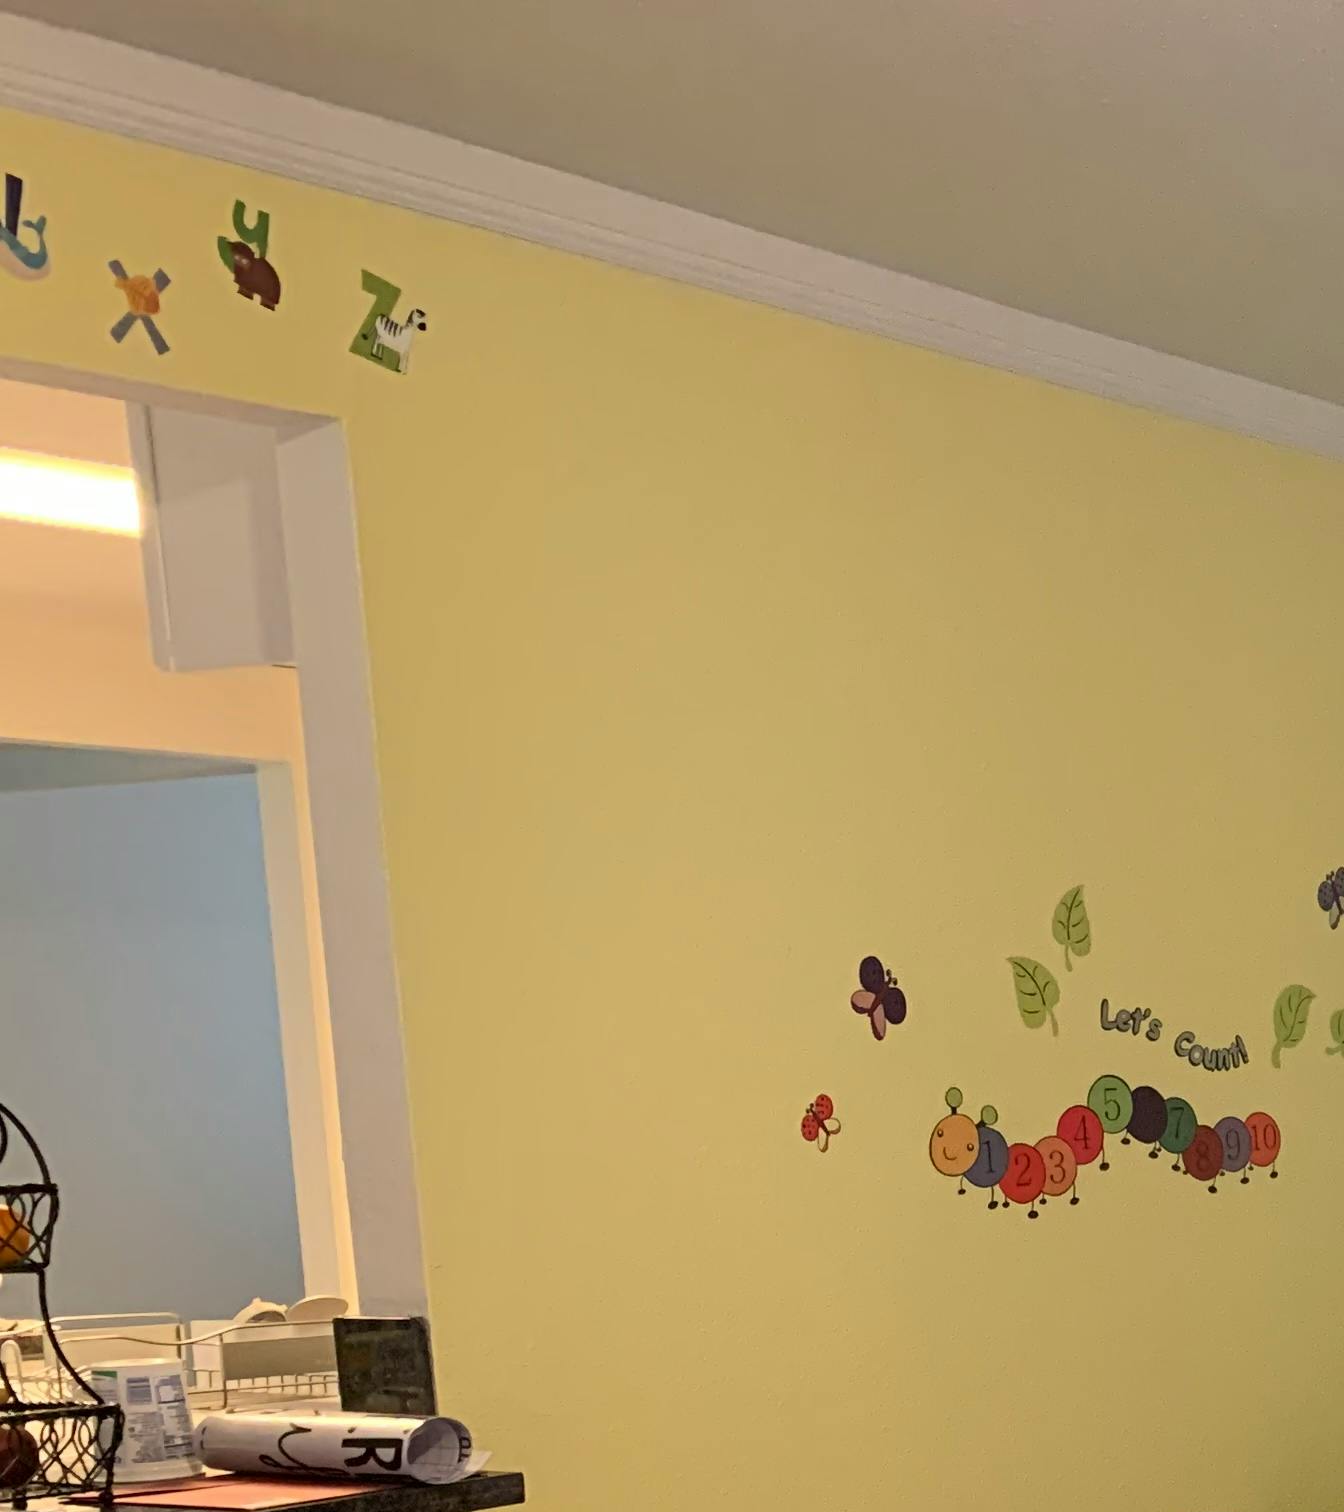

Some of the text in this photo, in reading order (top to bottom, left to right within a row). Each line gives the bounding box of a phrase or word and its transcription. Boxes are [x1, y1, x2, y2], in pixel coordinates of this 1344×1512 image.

[1100, 998, 1163, 1042] Let's
[982, 1139, 995, 1174] 1
[1014, 1152, 1032, 1187] 2
[1049, 1150, 1065, 1184] 3
[1073, 1115, 1090, 1151] 4
[1103, 1087, 1121, 1121] 5
[1170, 1106, 1186, 1140] 7
[1226, 1129, 1241, 1160] 9
[1251, 1123, 1277, 1151] 10
